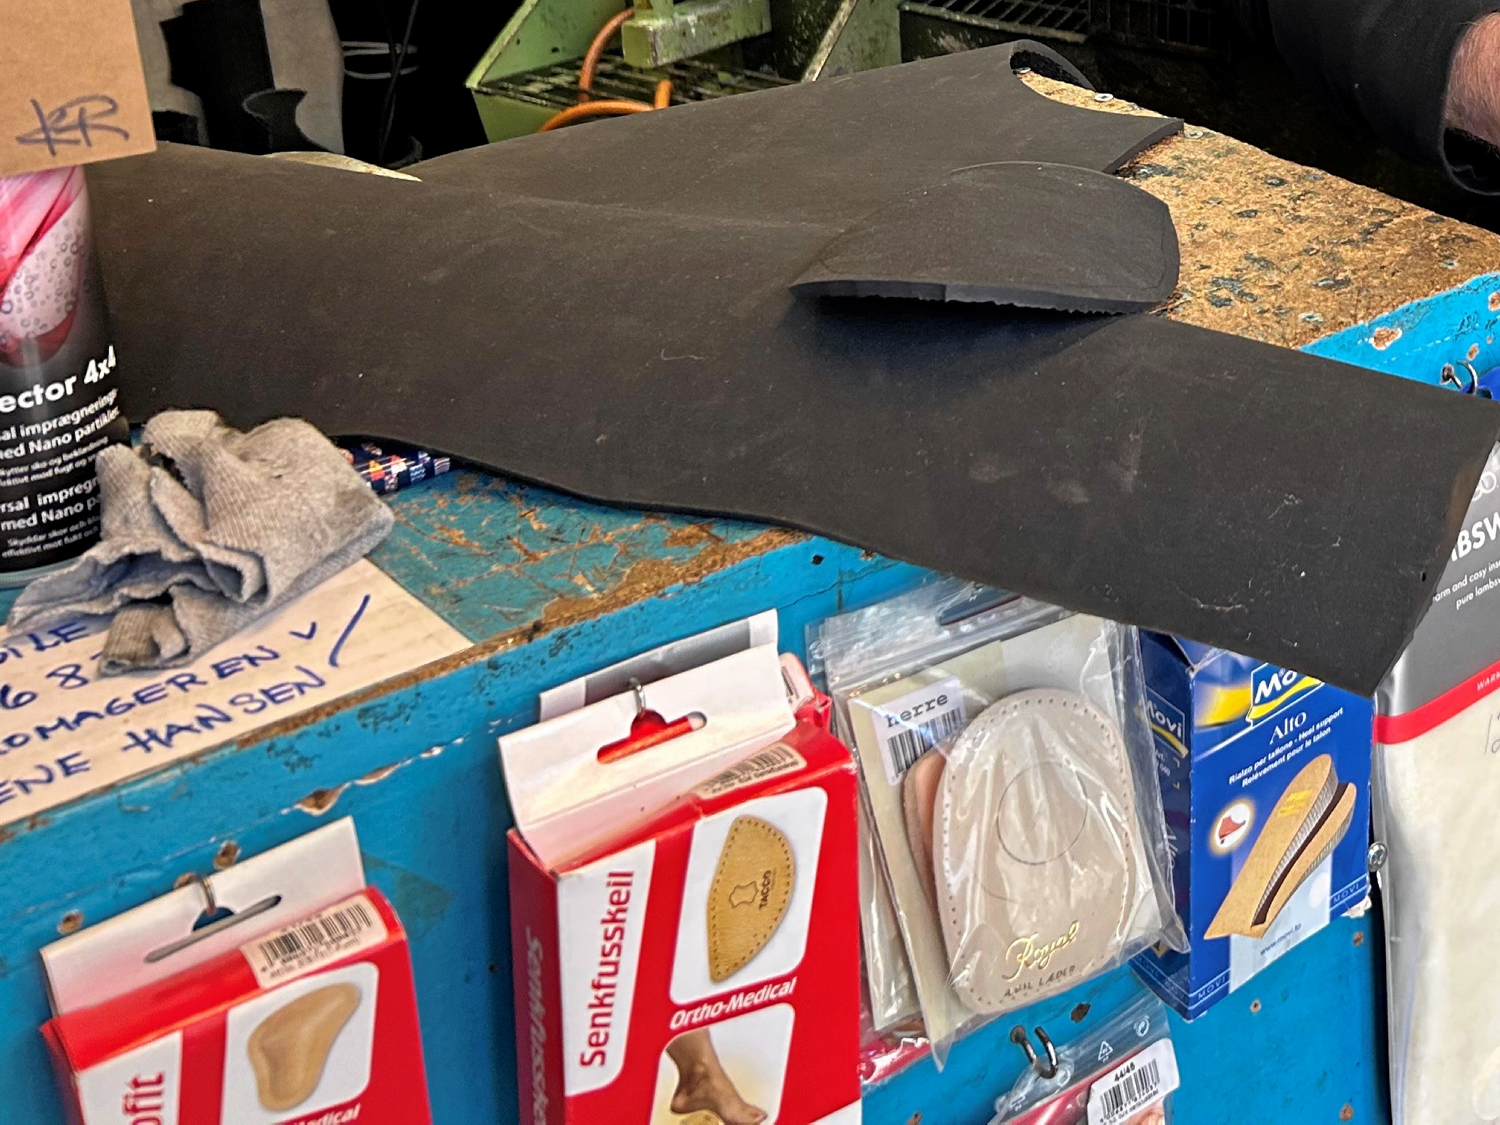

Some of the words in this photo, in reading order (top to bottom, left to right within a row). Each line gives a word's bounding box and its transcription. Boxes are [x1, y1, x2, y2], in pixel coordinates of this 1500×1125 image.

[28, 433, 72, 454] Nano
[1, 512, 38, 532] med
[41, 502, 84, 524] Nano
[1452, 575, 1468, 593] and
[1469, 567, 1487, 585] cosy
[1456, 592, 1474, 611] pure
[121, 665, 326, 753] HANSEN
[1269, 711, 1307, 745] Alto
[758, 869, 772, 911] TACCO
[1001, 921, 1080, 983] Royal
[579, 871, 635, 1069] Senkfusskeil
[669, 976, 798, 1031] Ortho-Medical
[1198, 975, 1226, 1001] MOVI
